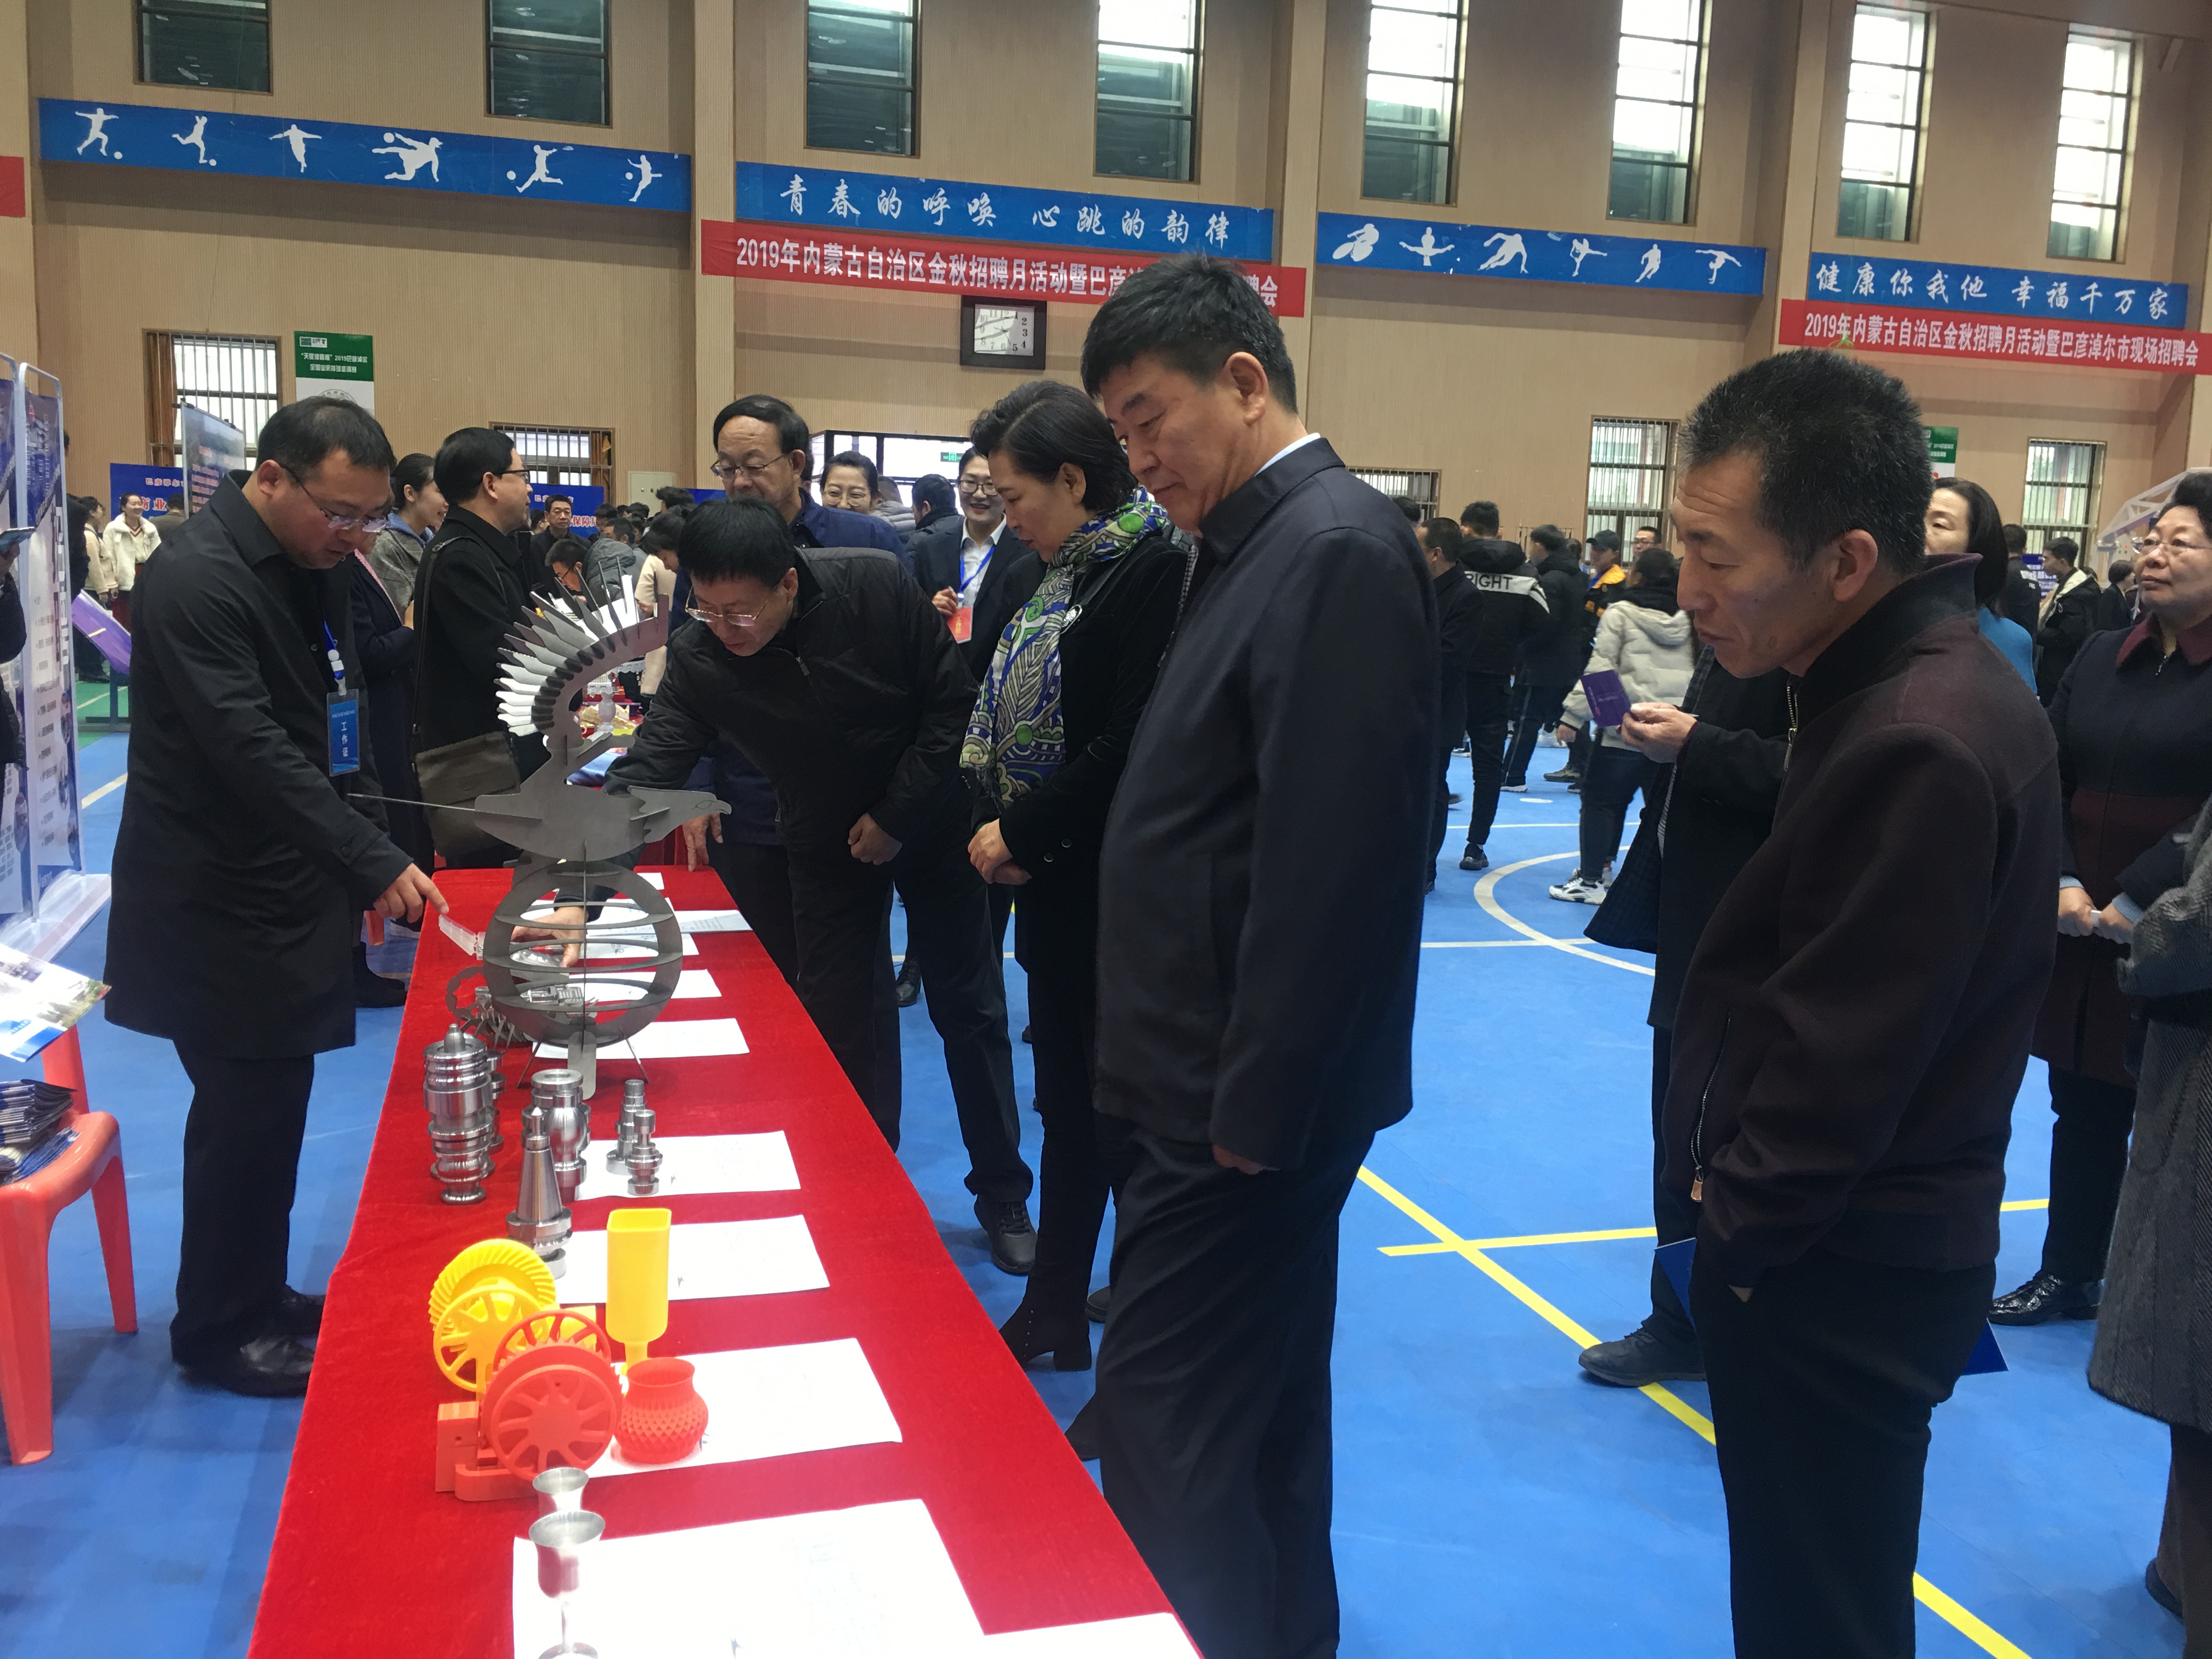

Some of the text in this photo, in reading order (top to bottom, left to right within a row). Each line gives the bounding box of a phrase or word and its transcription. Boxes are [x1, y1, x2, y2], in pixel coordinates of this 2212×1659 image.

[780, 173, 1229, 250] 青春的呼唤 心跳的韵律
[736, 237, 1278, 308] 2019年内蒙古自治区金秋招聘月活动暨巴彦会
[1816, 261, 2168, 320] 健康你我他 幸福千万家
[1000, 310, 1009, 319] 12
[1022, 329, 1028, 337] 3
[1804, 312, 2198, 368] 2019年内蒙古自治区金秋招聘月活动暨巴彦淖尔市现场招聘会
[1012, 343, 1018, 352] 5
